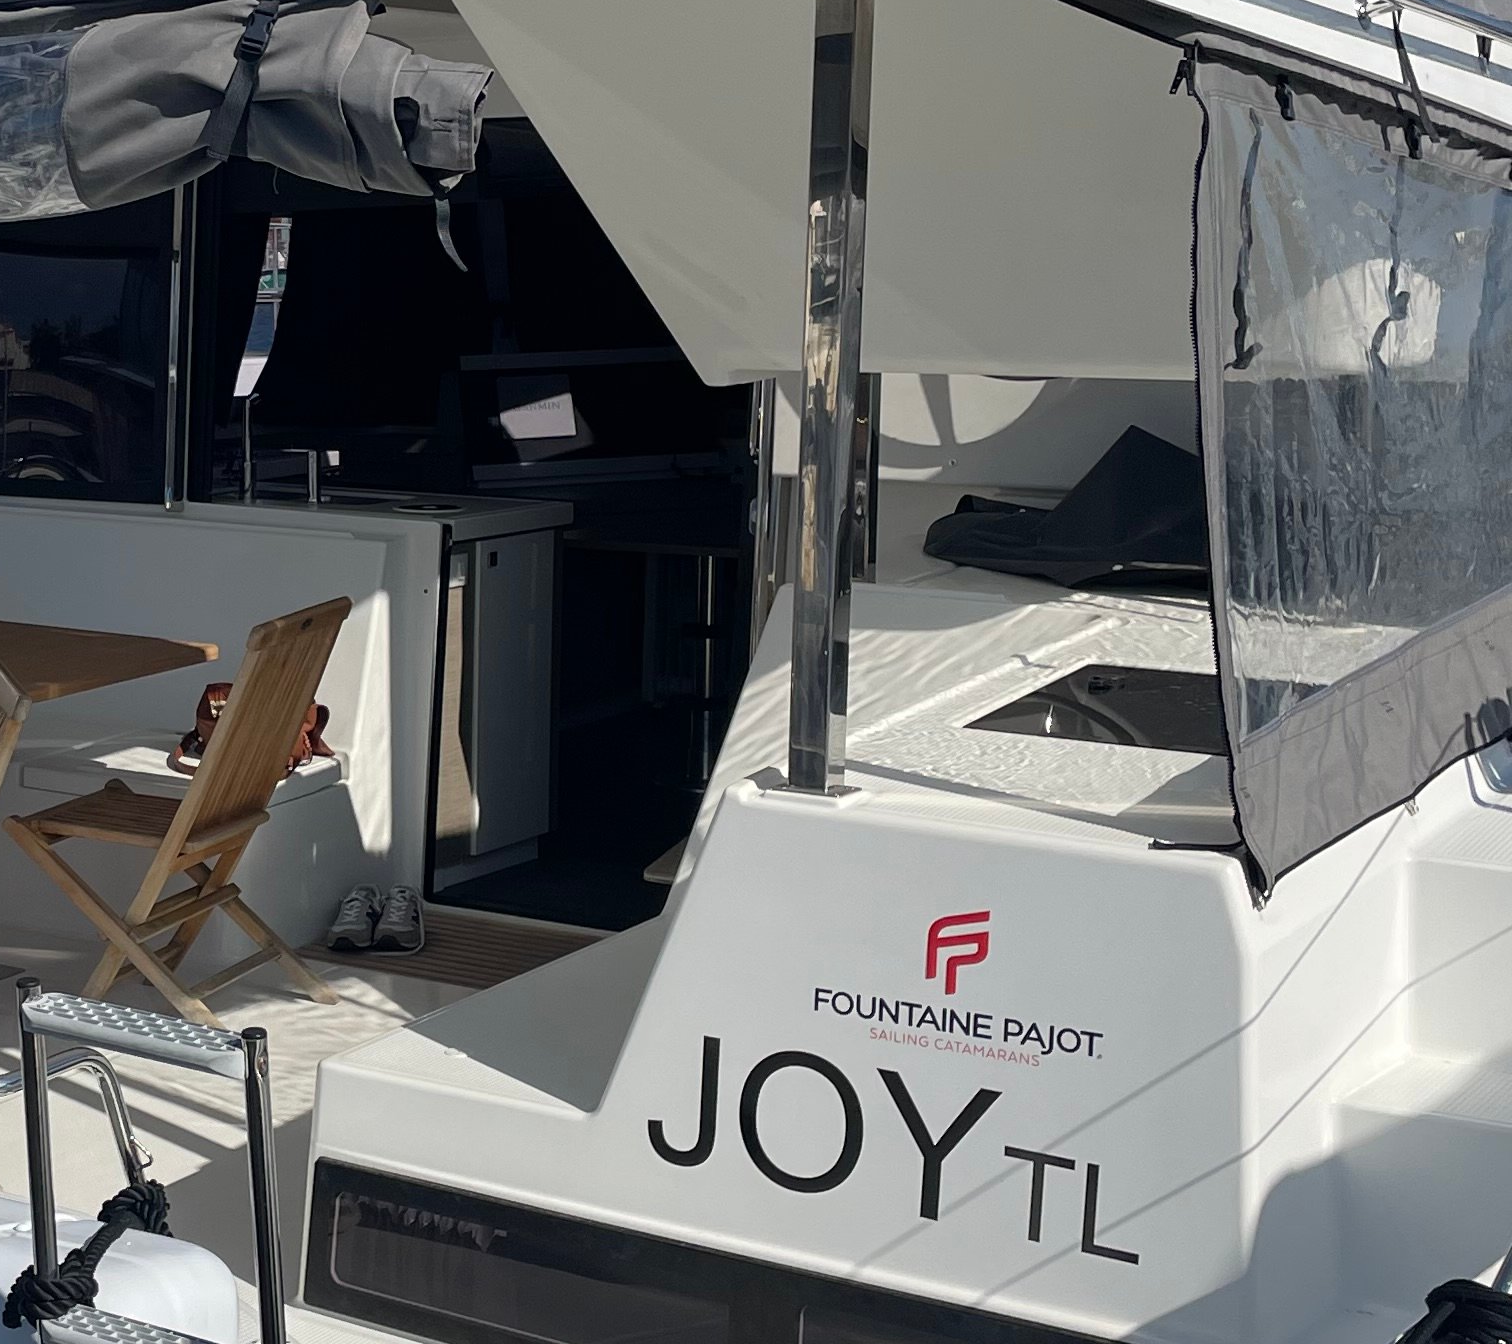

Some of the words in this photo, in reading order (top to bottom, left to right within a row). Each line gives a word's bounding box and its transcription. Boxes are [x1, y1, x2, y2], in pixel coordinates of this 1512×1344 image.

[813, 987, 993, 1040] FOUNTAINE
[869, 1027, 930, 1048] SAILING
[934, 1038, 1041, 1067] CATAMARANS
[647, 1035, 1003, 1221] JOY
[1004, 1145, 1140, 1266] TL
